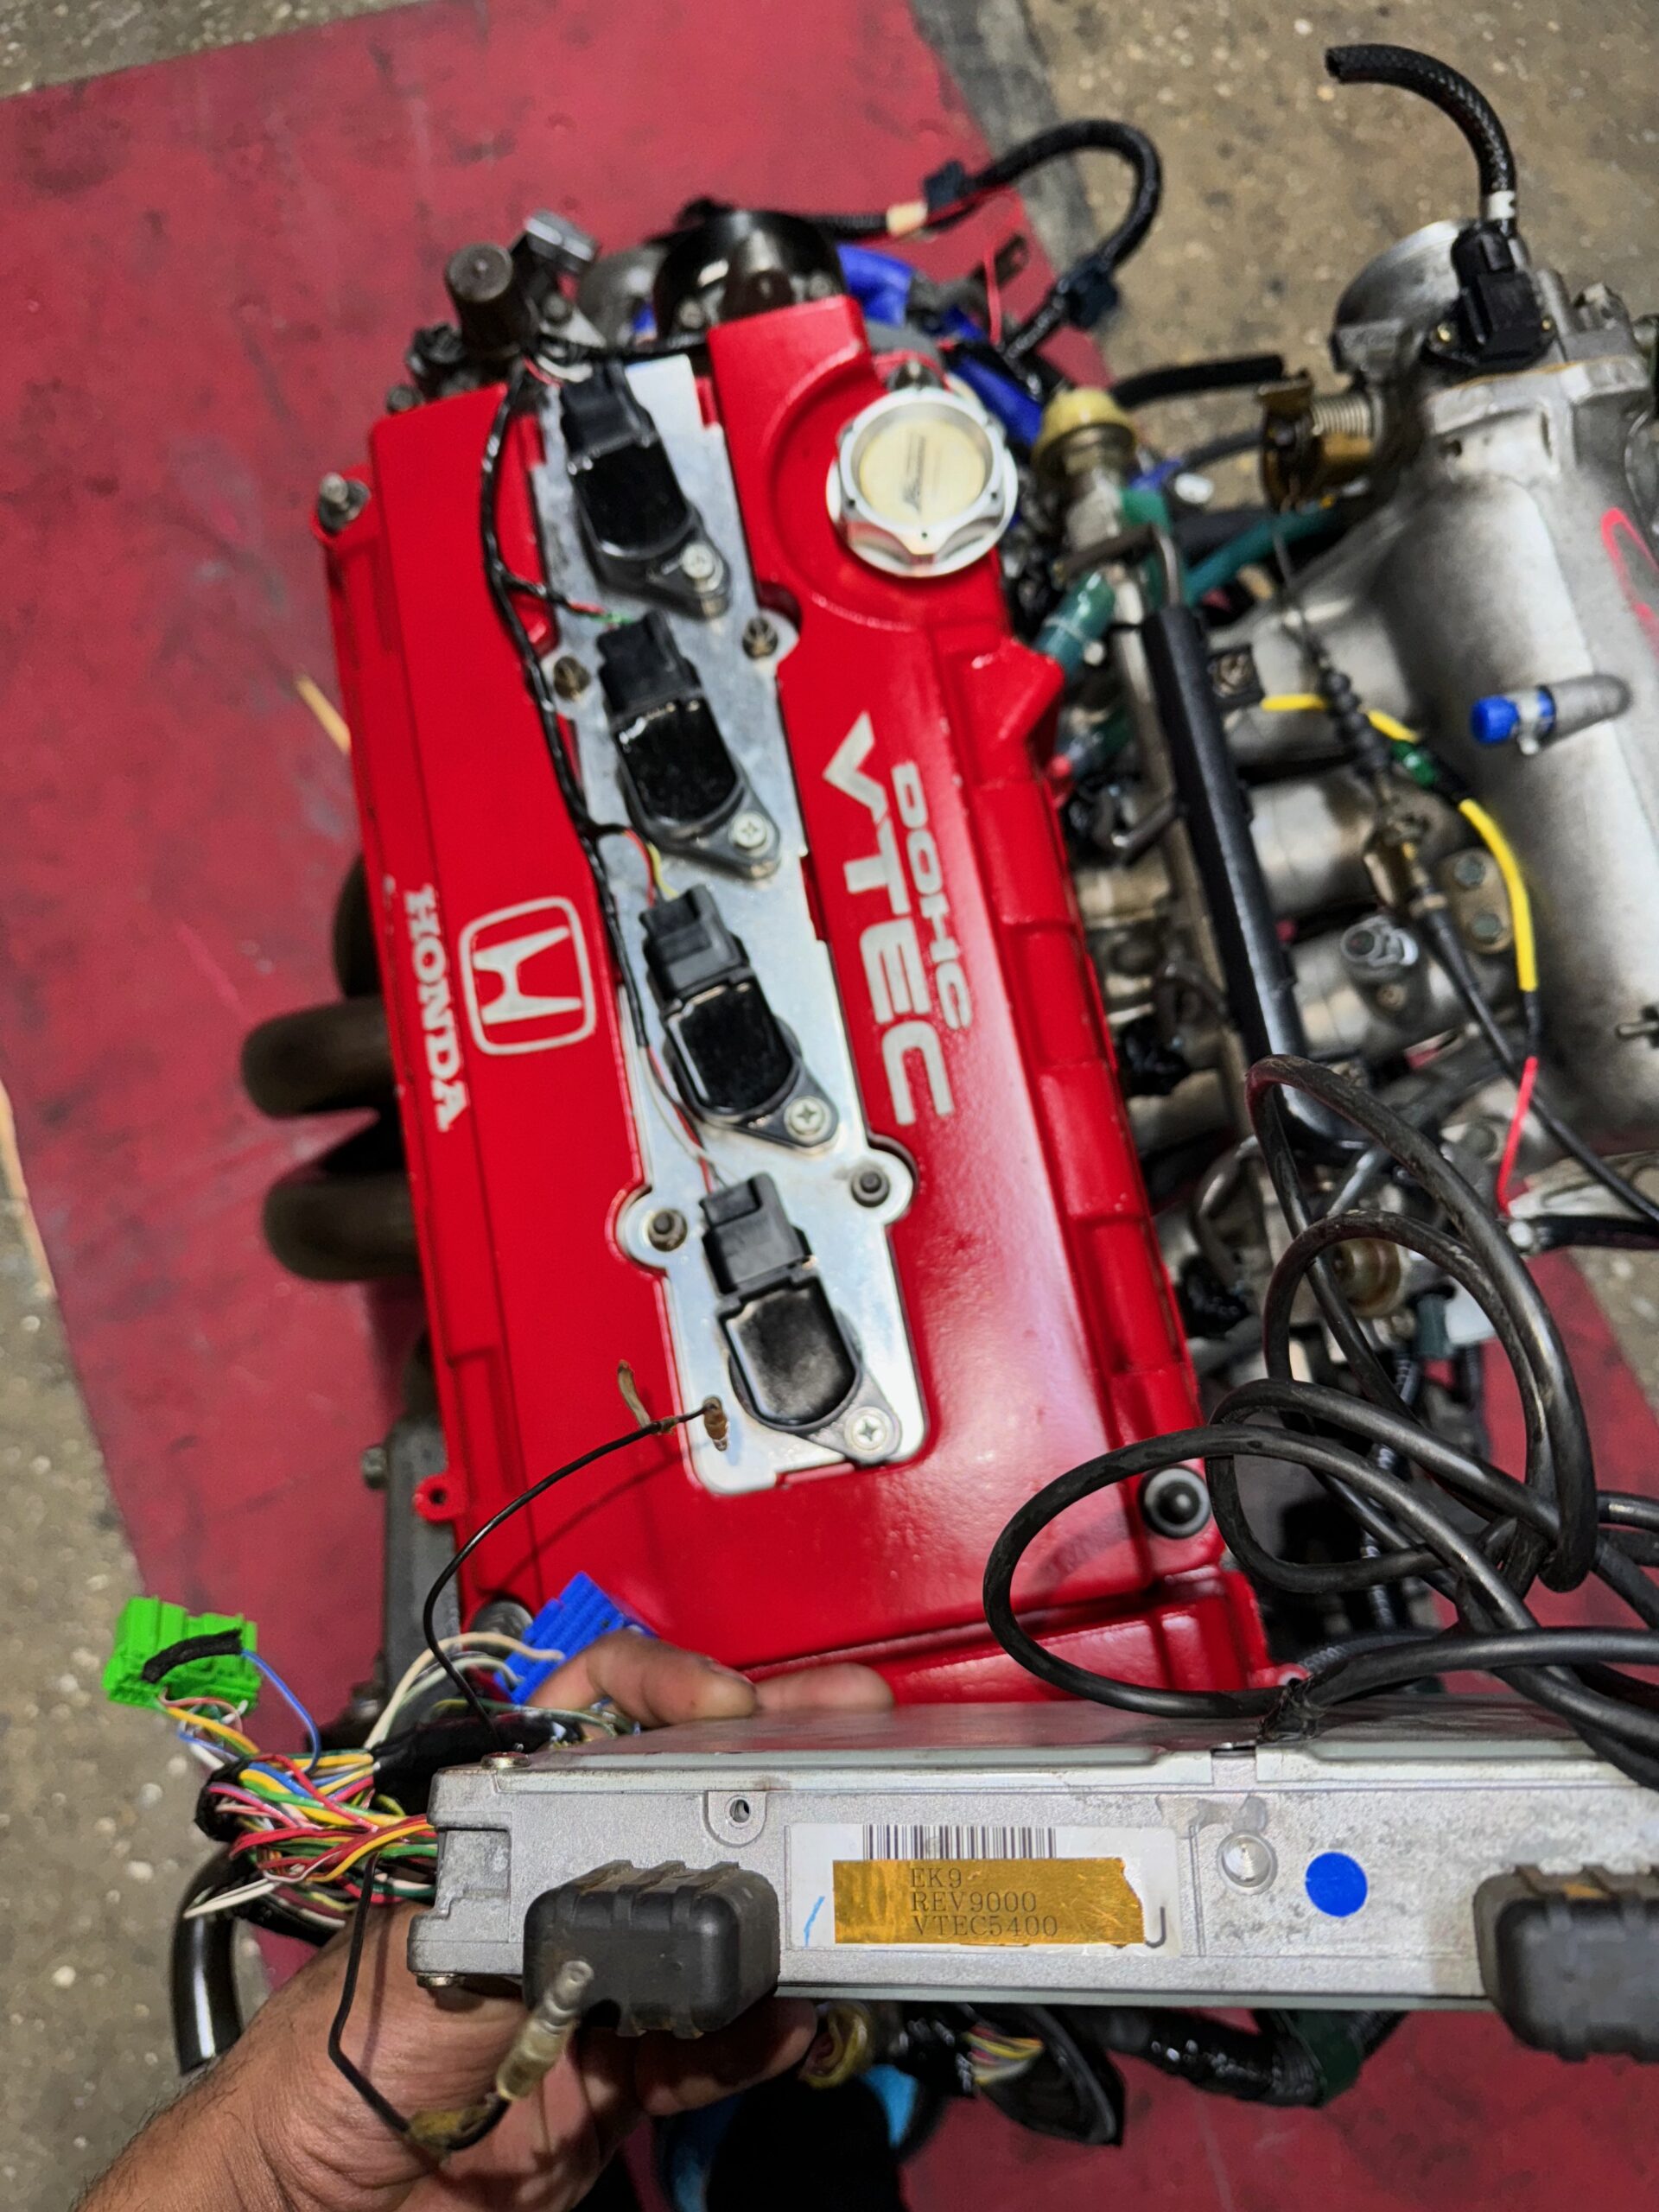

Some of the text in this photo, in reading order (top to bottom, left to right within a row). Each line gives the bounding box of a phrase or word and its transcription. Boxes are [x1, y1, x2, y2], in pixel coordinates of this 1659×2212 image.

[823, 710, 954, 1126] VTEC
[891, 760, 972, 1031] DOHC
[404, 883, 470, 1132] HONDA
[910, 1867, 963, 1889] EK9
[910, 1891, 1037, 1912] REV9000
[912, 1915, 1058, 1936] VTEC5400
